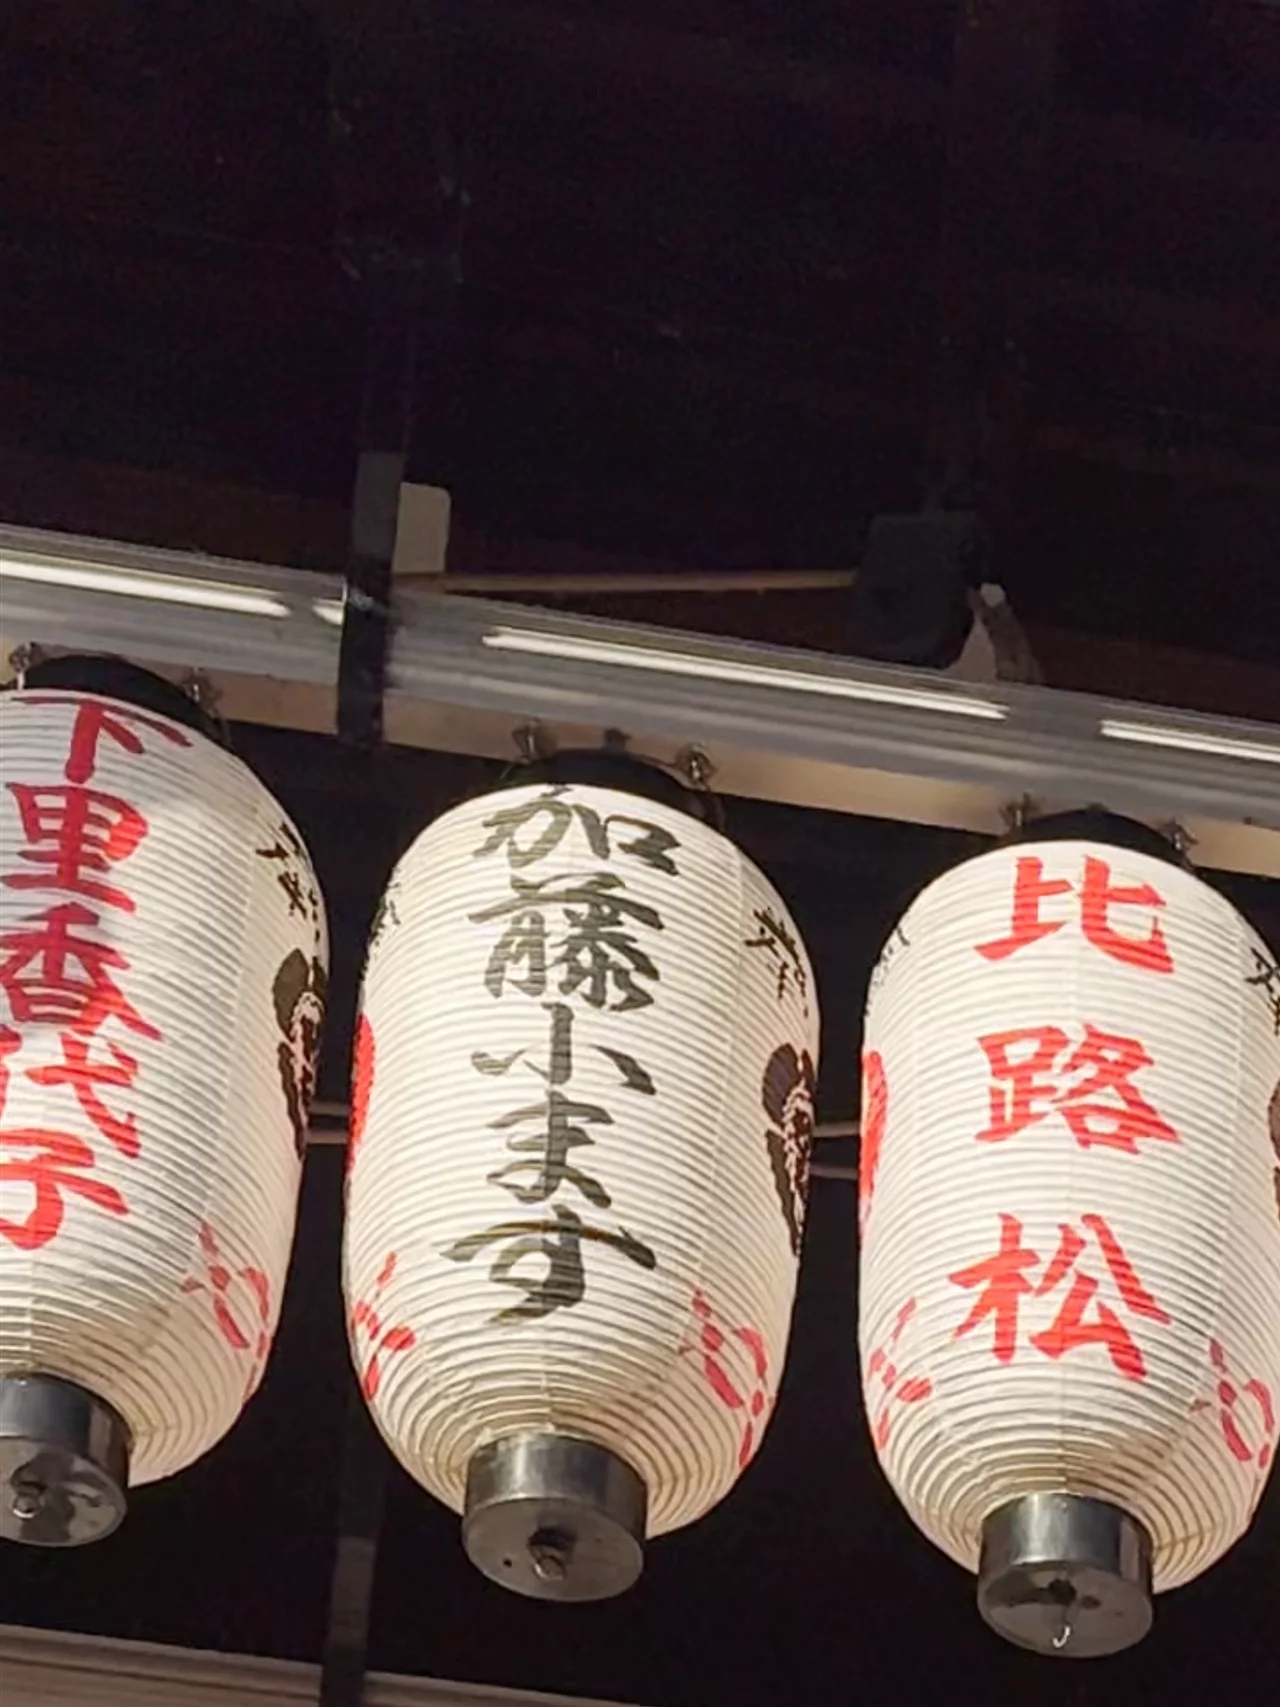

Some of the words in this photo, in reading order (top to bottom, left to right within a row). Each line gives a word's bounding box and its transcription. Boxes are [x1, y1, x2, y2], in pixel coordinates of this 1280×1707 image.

[440, 790, 683, 1326] 加藤小ます
[949, 853, 1183, 1383] 比路松
